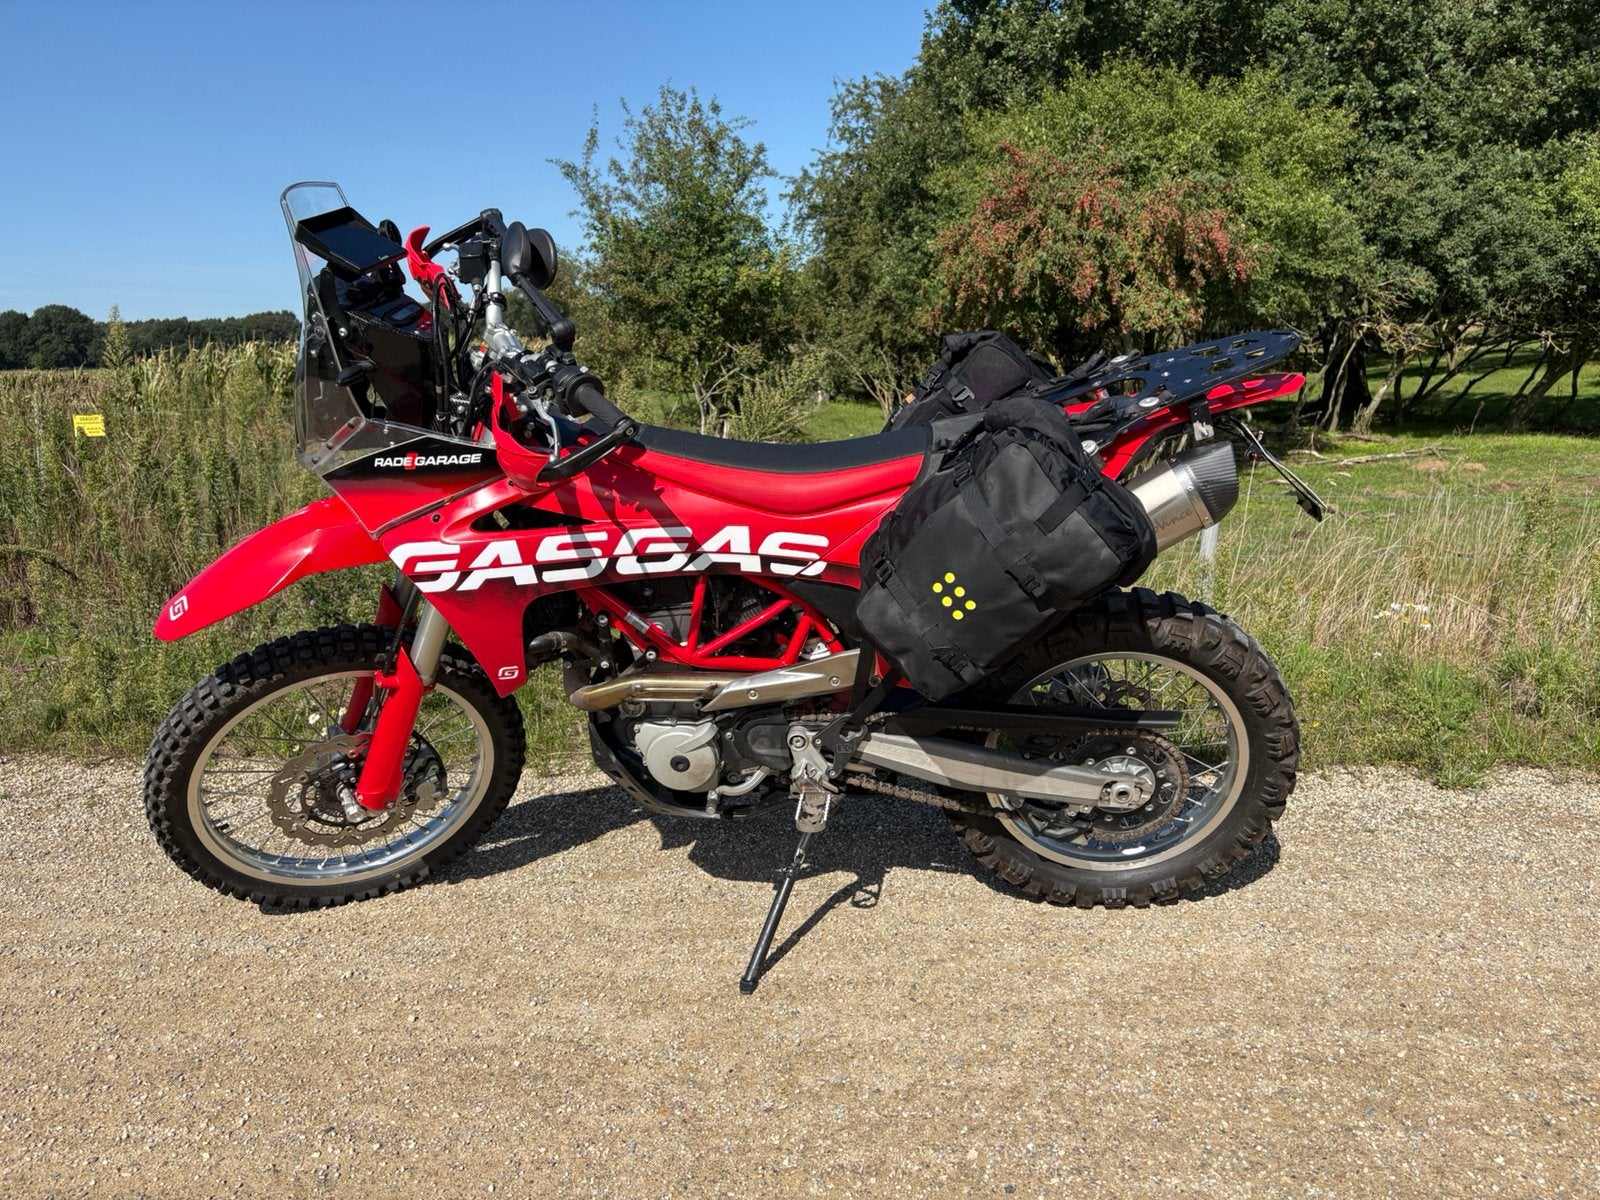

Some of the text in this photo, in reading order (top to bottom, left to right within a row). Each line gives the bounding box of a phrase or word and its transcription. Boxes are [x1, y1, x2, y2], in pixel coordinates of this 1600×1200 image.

[374, 453, 482, 468] RADE GARAGE
[1154, 508, 1193, 533] oVince
[389, 525, 830, 593] GASGAS
